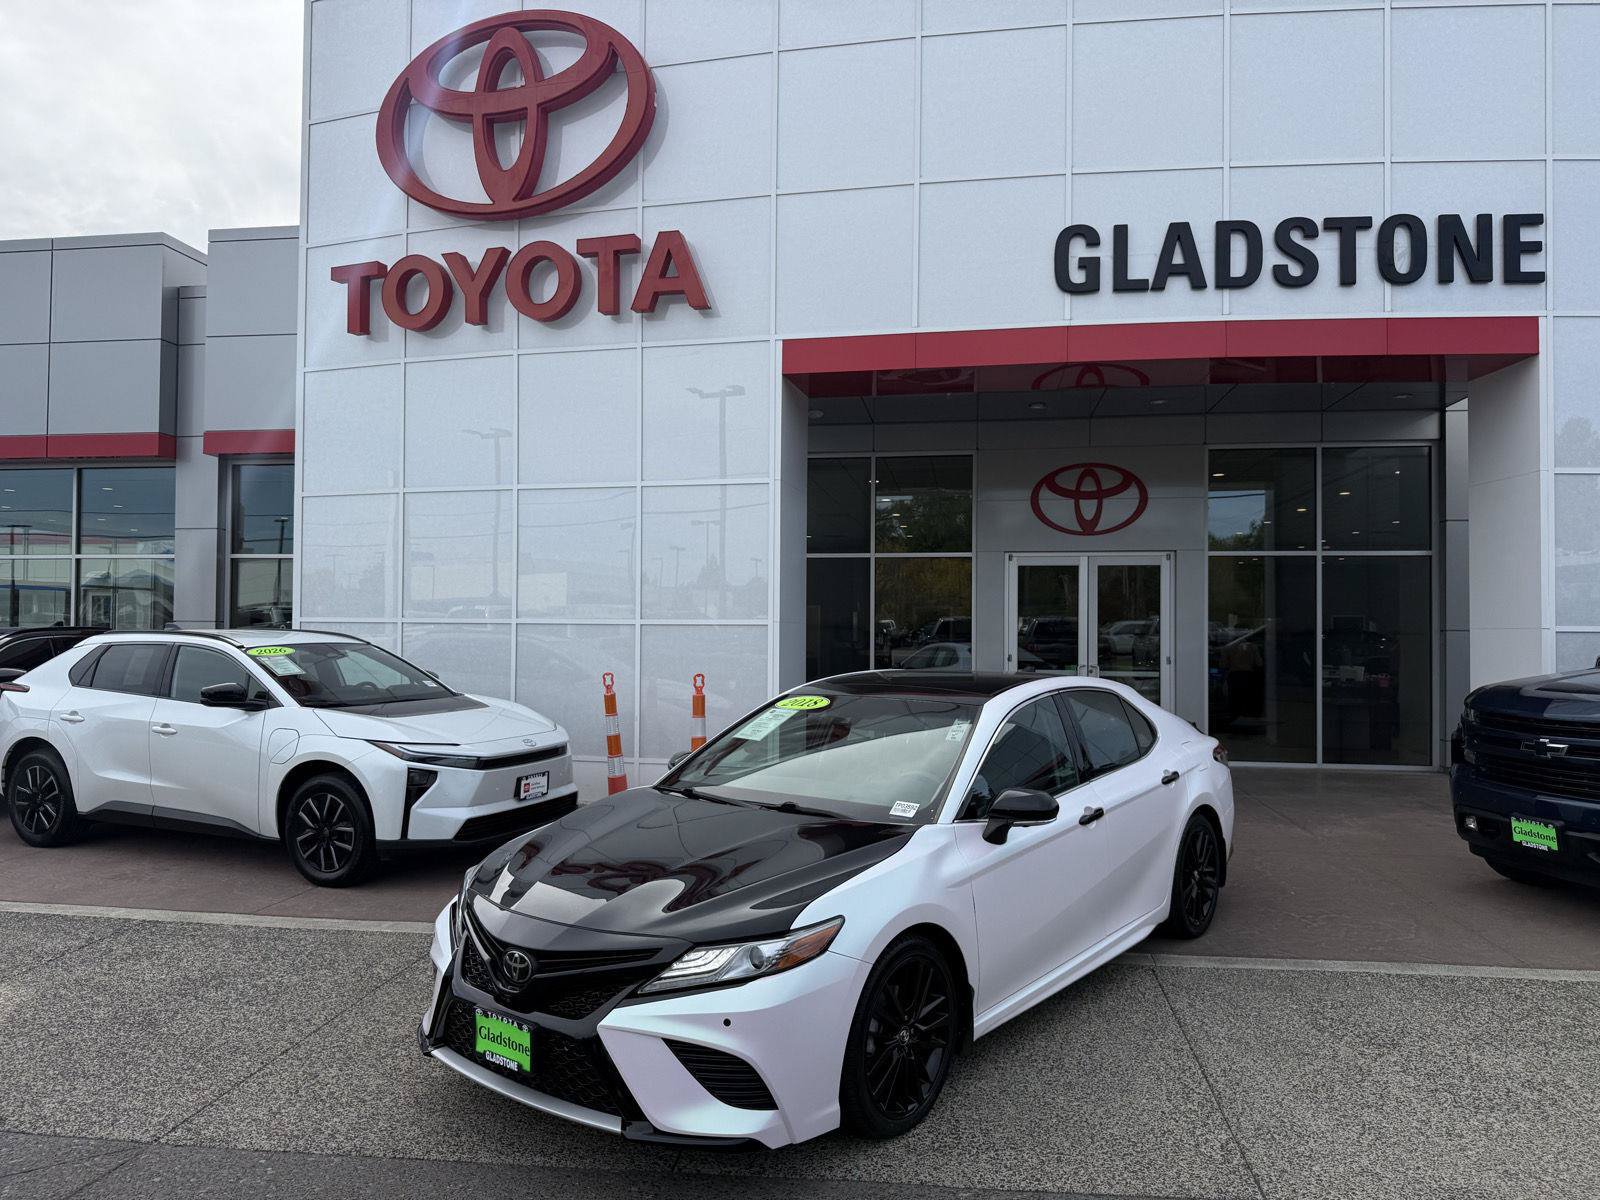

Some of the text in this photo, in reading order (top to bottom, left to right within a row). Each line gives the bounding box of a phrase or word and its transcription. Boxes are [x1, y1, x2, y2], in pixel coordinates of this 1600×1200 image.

[1054, 213, 1546, 295] GLADSTONE
[331, 229, 712, 336] TOYOTA
[256, 647, 287, 655] 2026
[779, 698, 824, 708] 2018
[1513, 825, 1557, 843] Gladstone
[1521, 840, 1549, 852] GLADSTONE
[487, 1011, 519, 1029] TOYOTA
[478, 1025, 531, 1057] Gladstone
[485, 1050, 519, 1072] GLADSTONE
